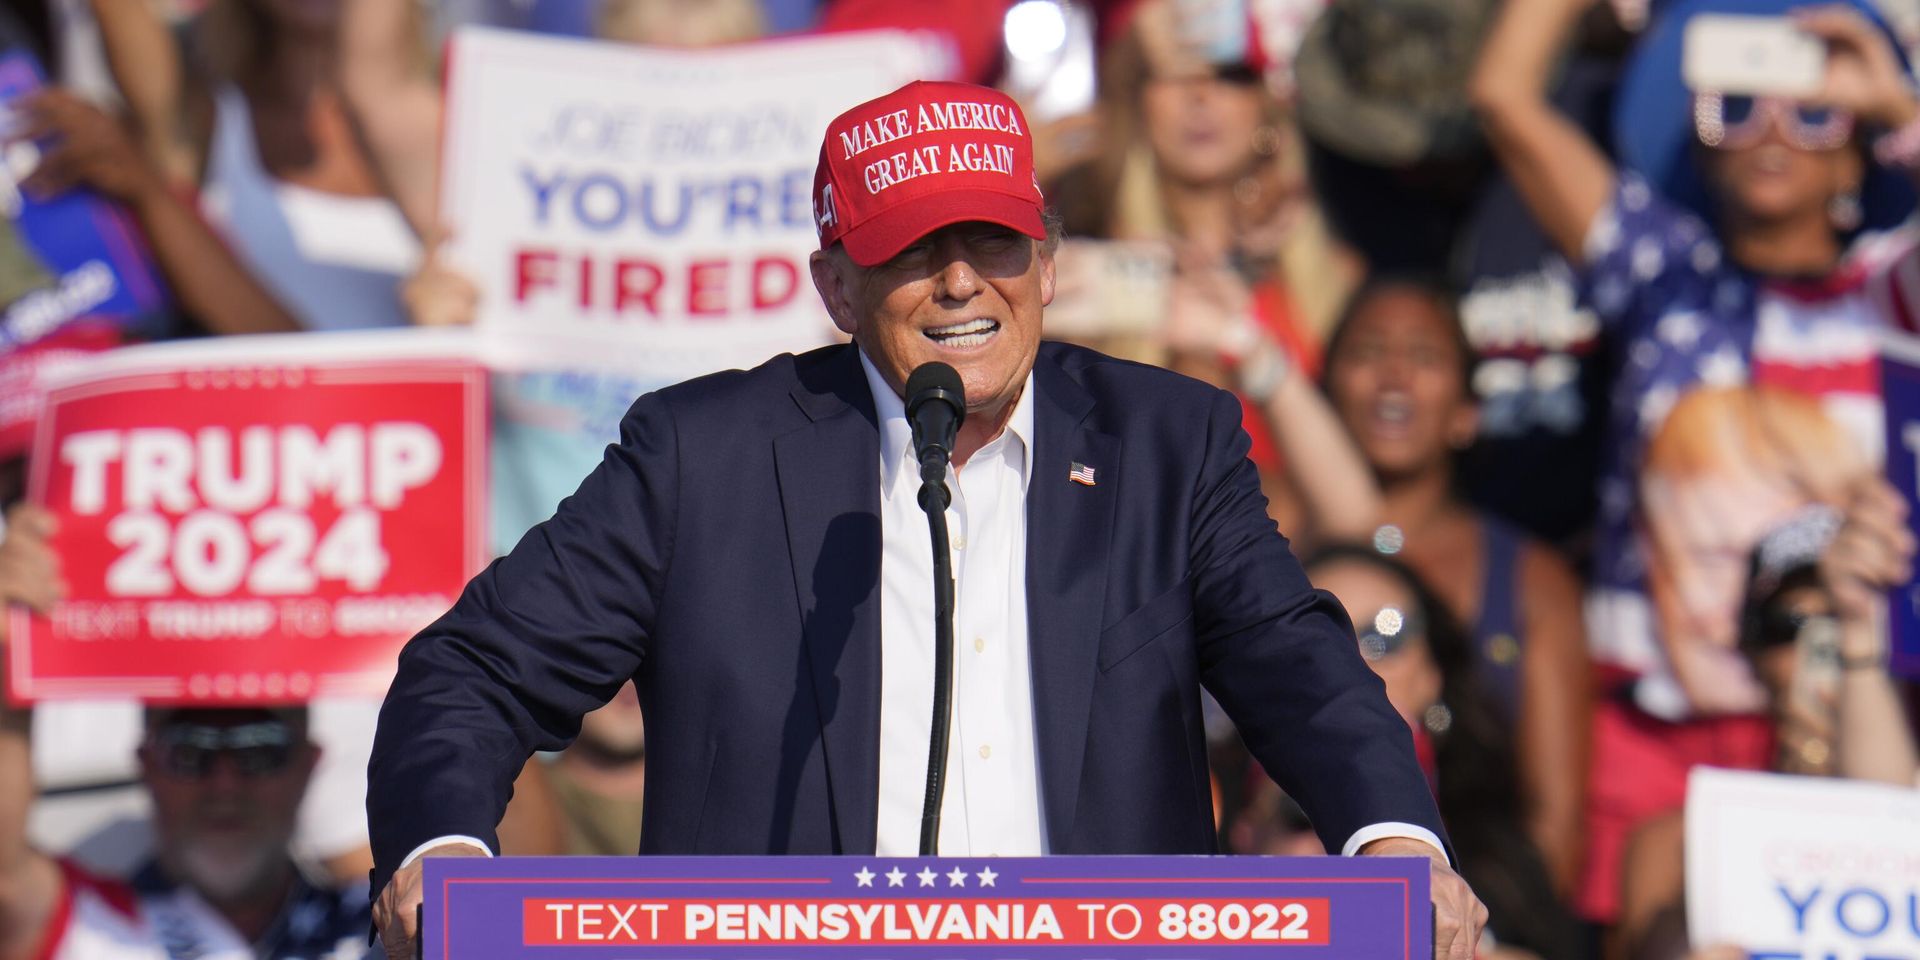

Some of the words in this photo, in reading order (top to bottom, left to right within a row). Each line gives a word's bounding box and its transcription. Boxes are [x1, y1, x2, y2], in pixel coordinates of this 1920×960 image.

[839, 108, 912, 160] MAKE
[916, 102, 1023, 136] AMERICA
[864, 145, 941, 195] GREAT
[948, 143, 1014, 177] AGAIN
[61, 421, 443, 515] TRUMP
[105, 507, 389, 596] 2024
[545, 903, 669, 940] TEXT
[684, 903, 1064, 941] PENNSYLVANIA
[1076, 903, 1143, 941] TO
[1157, 903, 1309, 941] 88022
